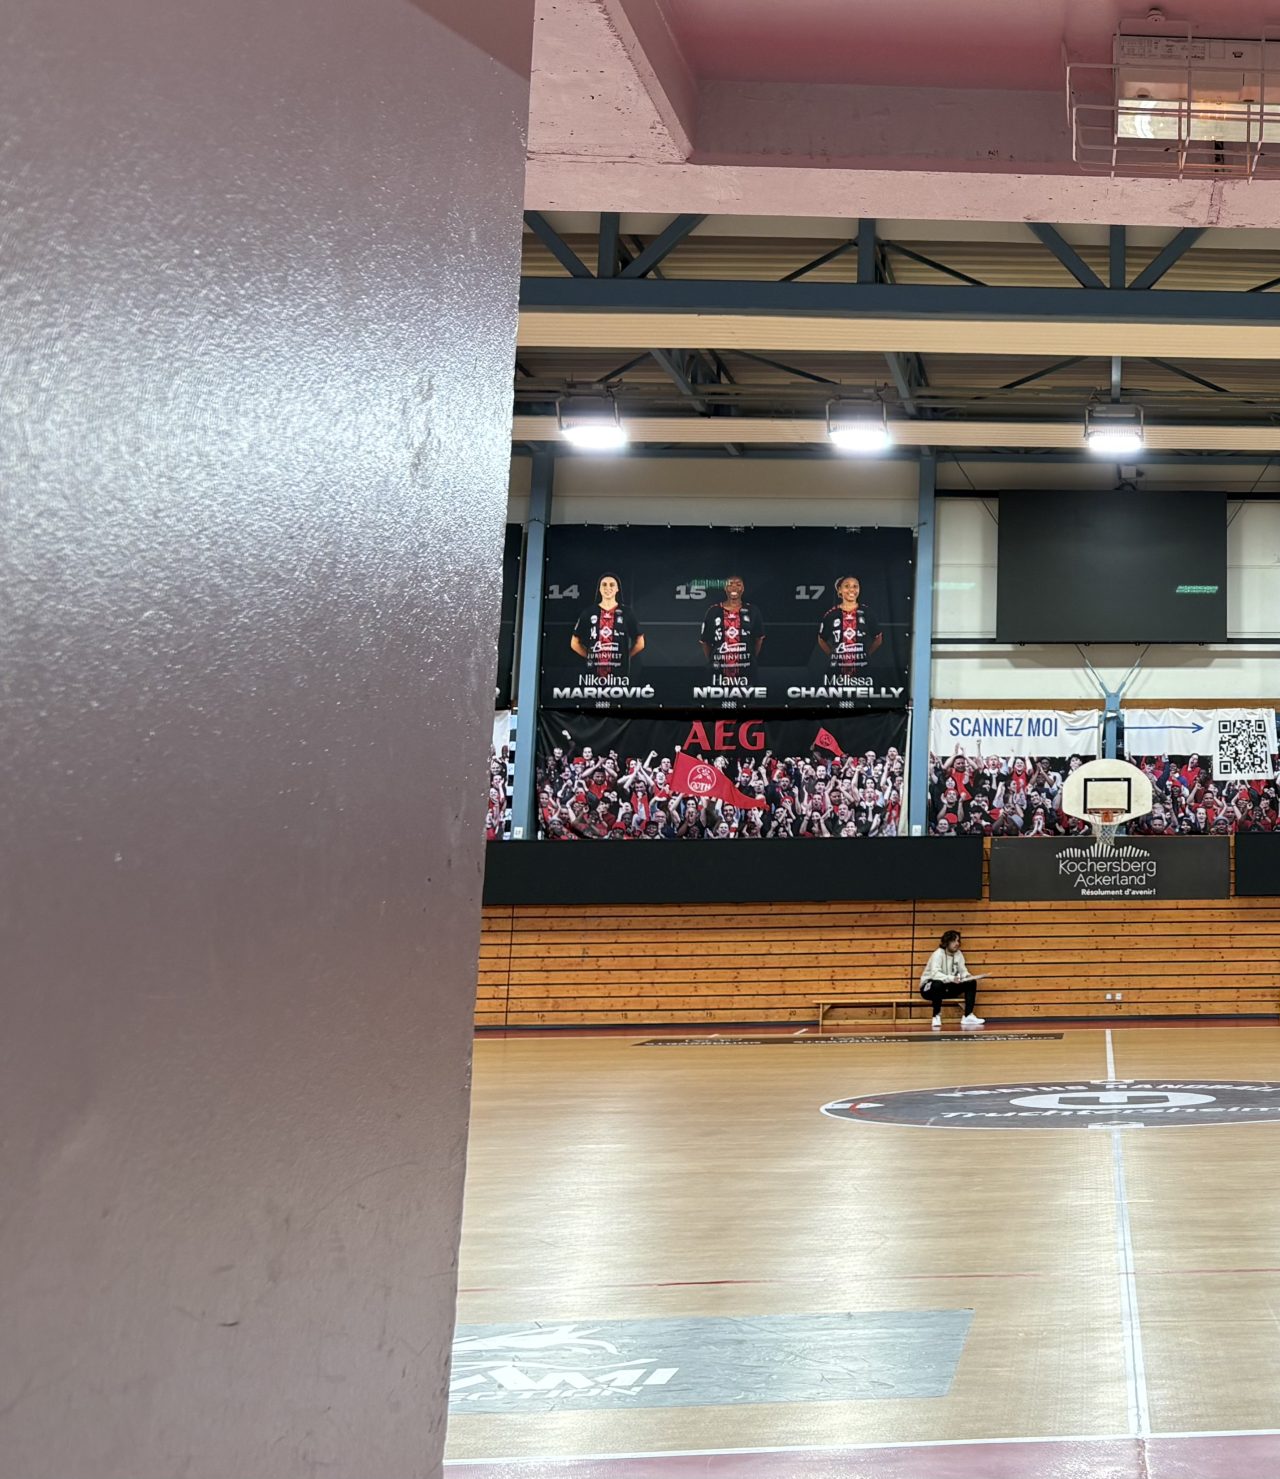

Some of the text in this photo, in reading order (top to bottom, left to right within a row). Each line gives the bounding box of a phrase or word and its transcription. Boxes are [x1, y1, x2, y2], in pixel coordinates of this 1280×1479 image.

[548, 584, 580, 600] 14
[675, 585, 706, 600] 15
[795, 585, 826, 600] 17
[578, 674, 630, 686] Nikolina
[712, 674, 748, 686] Hawa
[824, 674, 873, 686] Mélissa
[552, 684, 655, 698] MARKOVIĆ
[694, 686, 767, 698] N'DIAYE
[787, 686, 904, 698] CHANTELLY
[950, 717, 1058, 737] SCANNEZ MOI
[682, 720, 765, 750] AEG
[1059, 858, 1157, 876] Kochersberg
[1074, 873, 1146, 887] Ackerland
[1081, 888, 1123, 896] Résolument
